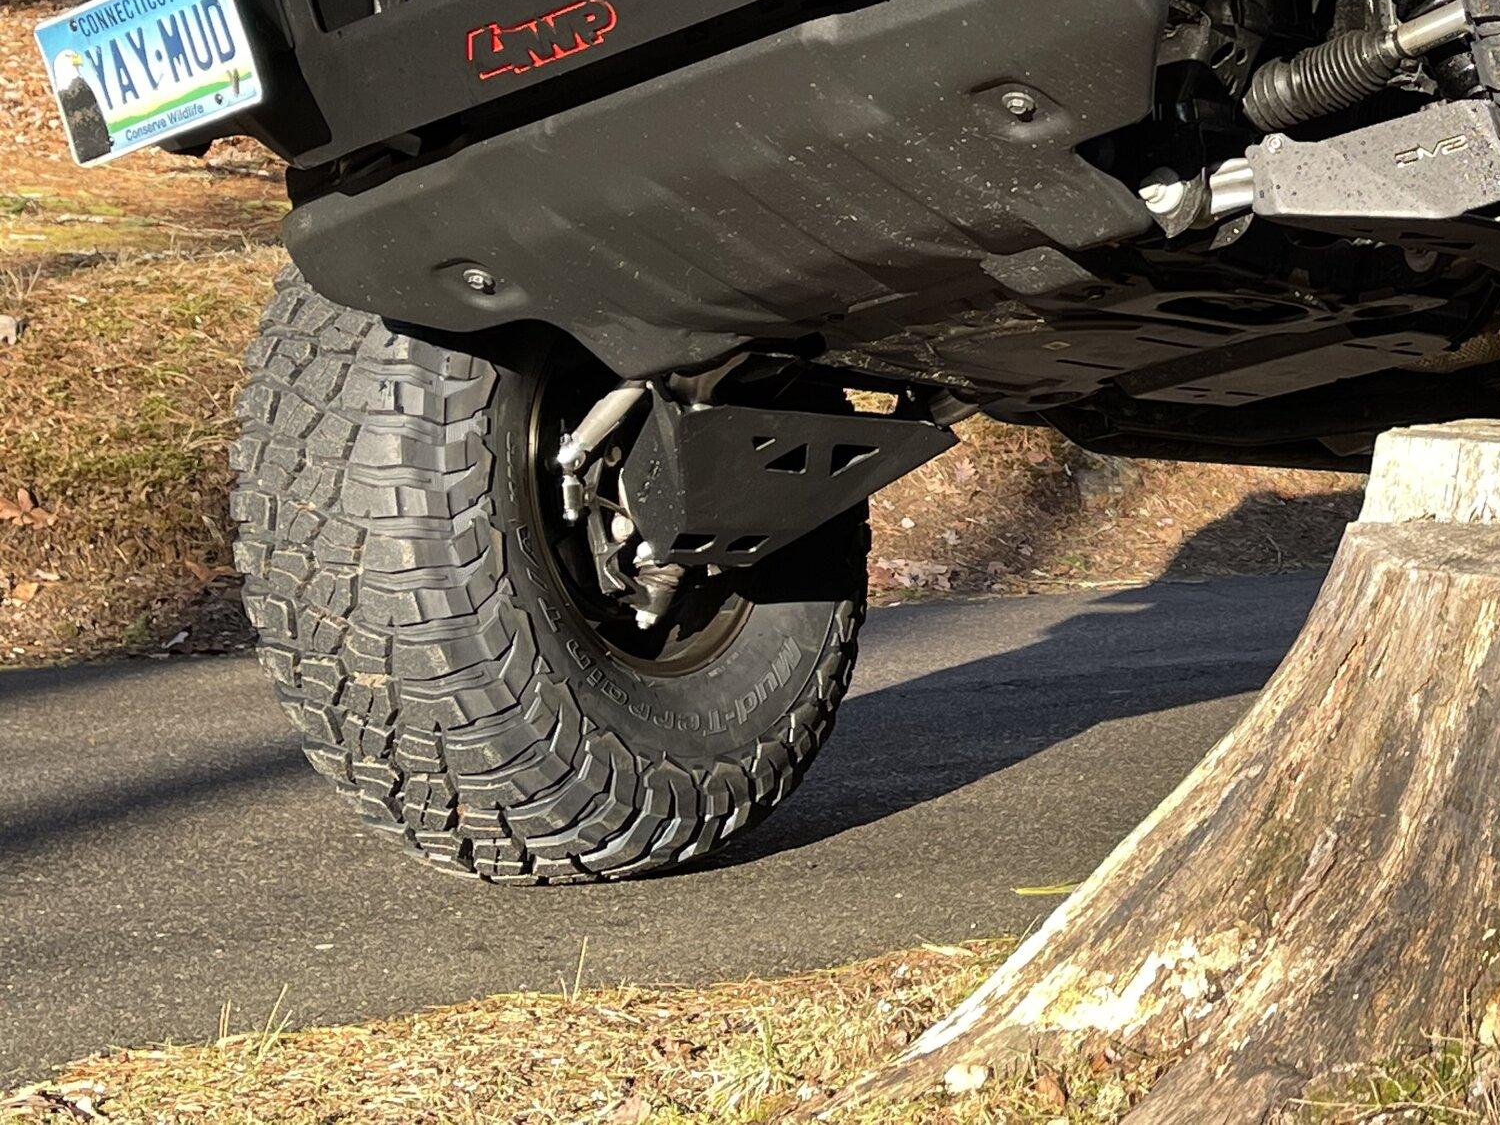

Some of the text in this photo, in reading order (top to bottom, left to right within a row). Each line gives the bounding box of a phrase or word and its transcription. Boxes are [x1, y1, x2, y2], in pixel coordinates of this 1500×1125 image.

[125, 103, 205, 142] Conserve Wildlife
[565, 636, 803, 737] Mud-Terrain
